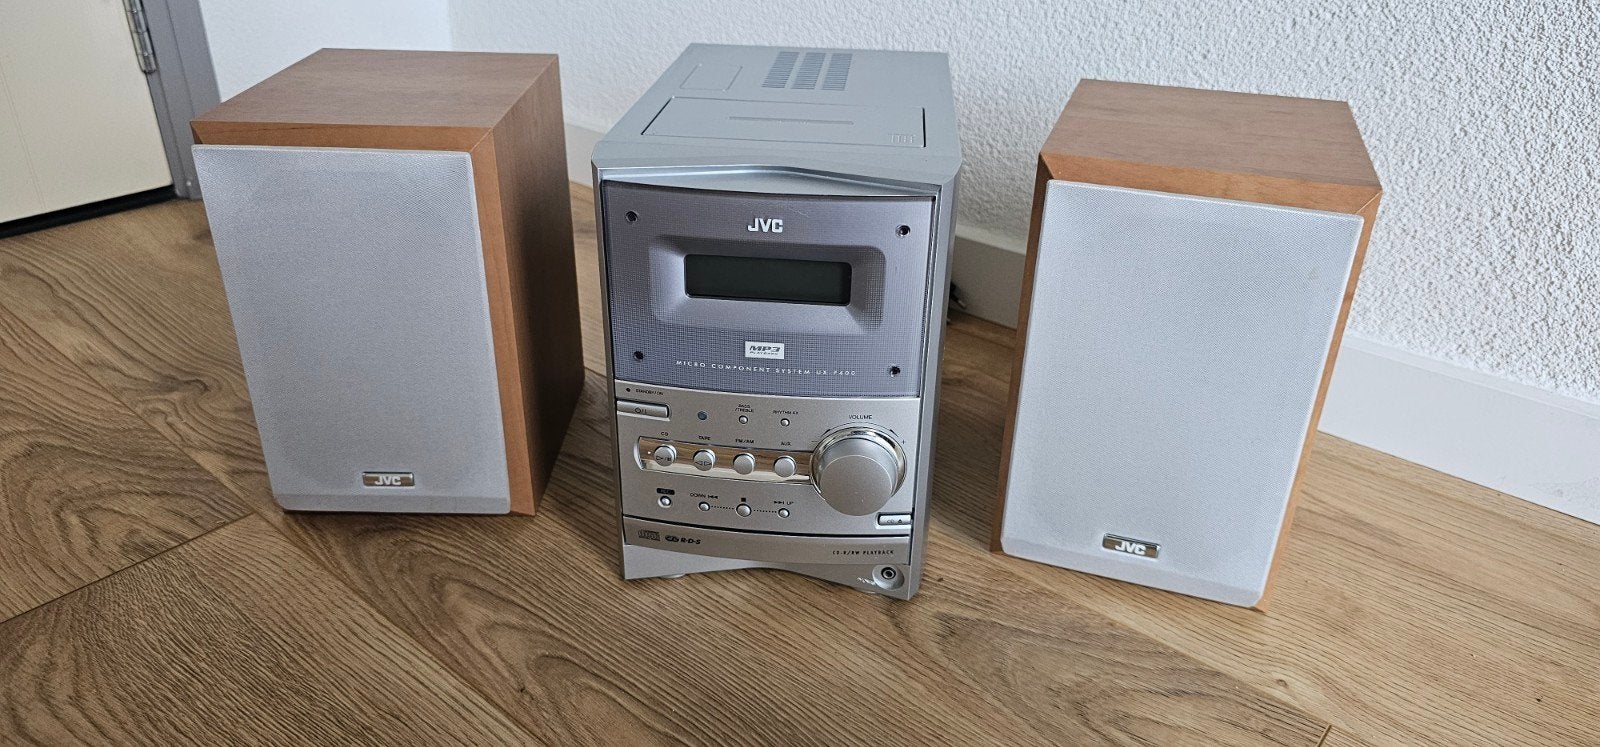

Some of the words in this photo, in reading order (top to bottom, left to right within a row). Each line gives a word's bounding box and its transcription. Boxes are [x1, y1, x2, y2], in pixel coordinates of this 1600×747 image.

[747, 217, 784, 233] JVC
[676, 360, 706, 368] MICRO
[711, 363, 770, 373] COMPONENT
[374, 475, 402, 486] JVC
[1114, 541, 1147, 555] JVC
